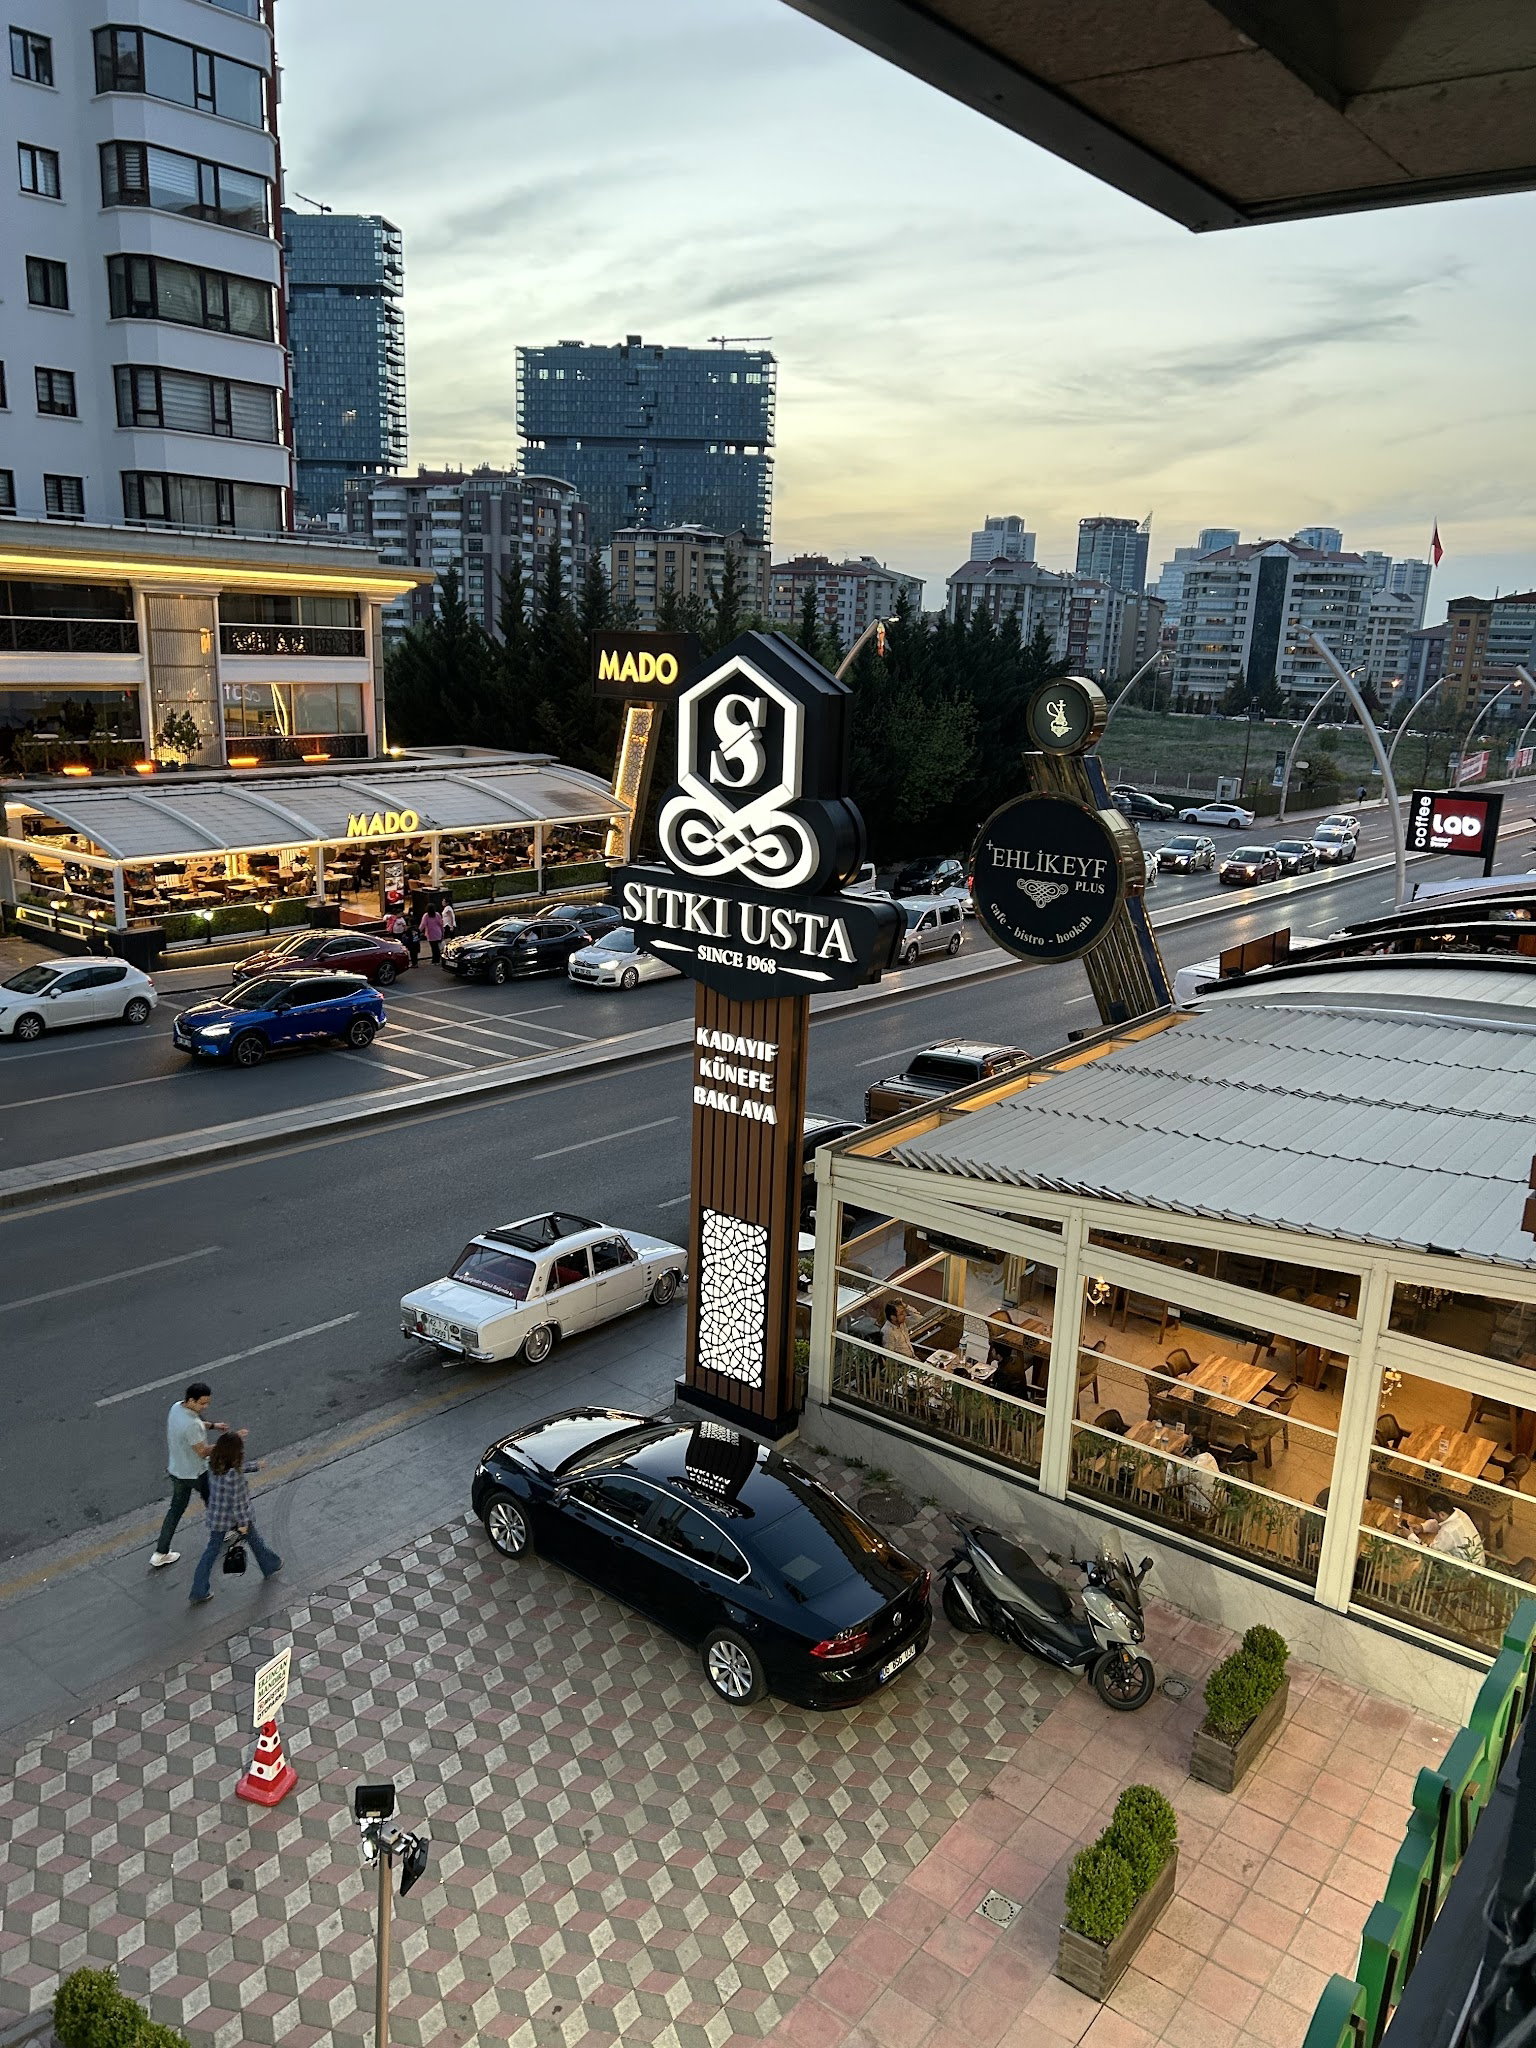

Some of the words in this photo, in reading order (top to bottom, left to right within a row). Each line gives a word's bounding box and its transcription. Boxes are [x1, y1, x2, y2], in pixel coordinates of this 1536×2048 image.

[598, 649, 679, 685] MADO
[346, 809, 420, 838] MADO
[1414, 796, 1432, 847] coffee
[1075, 881, 1106, 895] PLUS
[622, 881, 733, 938] SITKI
[738, 901, 858, 963] USTA
[990, 903, 1007, 925] cafe
[1013, 926, 1045, 946] bistro
[1055, 915, 1093, 944] hookah
[697, 944, 744, 968] SINCE
[746, 954, 777, 975] 1968
[696, 1026, 779, 1062] KADAYIF
[699, 1055, 774, 1093] KÜNEFE
[693, 1085, 778, 1125] BAKLAVA
